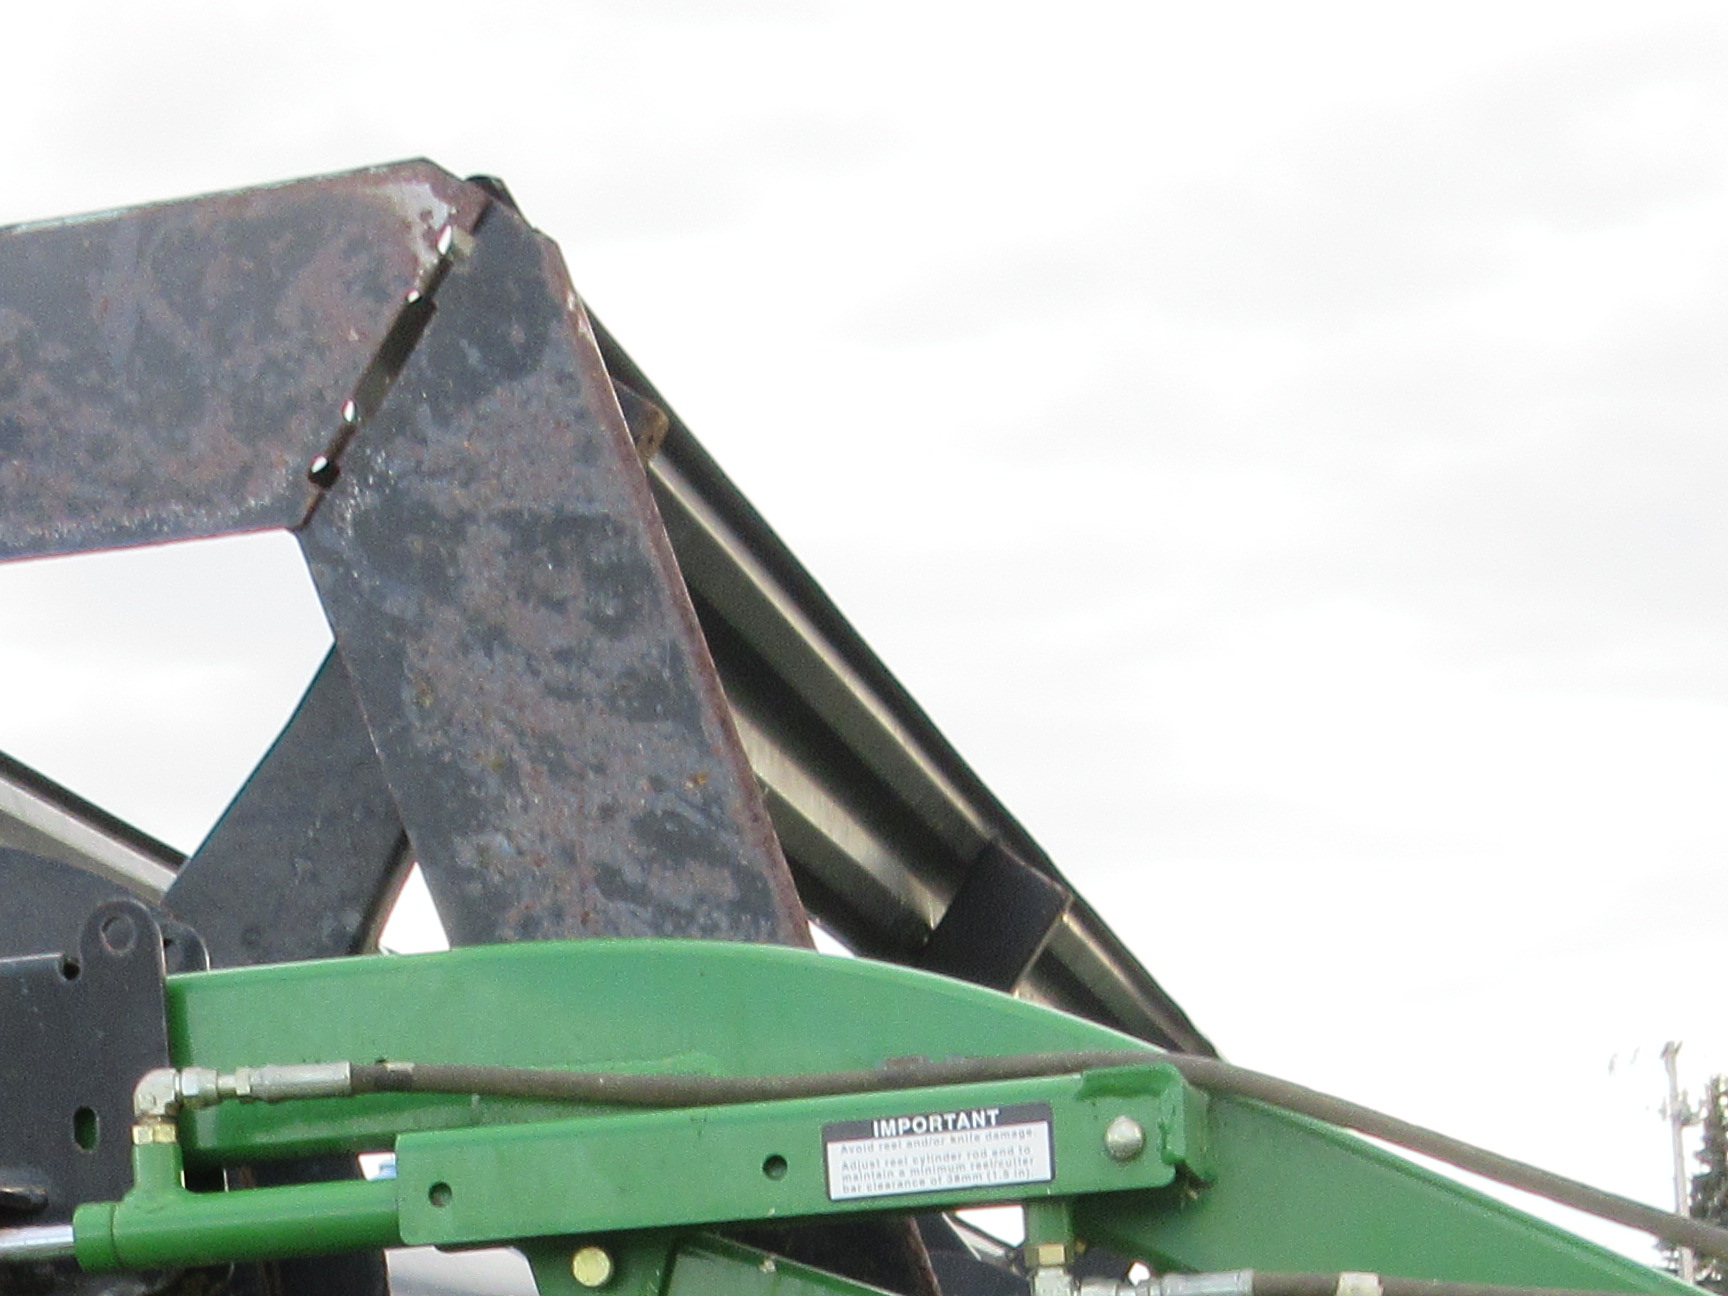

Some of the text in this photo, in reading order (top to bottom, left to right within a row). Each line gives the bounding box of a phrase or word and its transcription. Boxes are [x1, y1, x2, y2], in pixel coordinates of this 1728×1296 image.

[873, 1108, 1000, 1138] IMPORTANT
[841, 1143, 874, 1154] Avoid
[879, 1141, 902, 1150] reel
[906, 1136, 945, 1149] and/or
[950, 1133, 981, 1145] knife
[842, 1159, 880, 1172] Adjust
[885, 1157, 908, 1167] reel
[912, 1151, 962, 1167] cylinder
[967, 1148, 988, 1159] rod
[1018, 1145, 1031, 1155] to
[841, 1169, 894, 1182] maintain
[910, 1162, 966, 1177] minimum
[842, 1183, 862, 1194] bar
[866, 1178, 926, 1191] clearance
[930, 1175, 942, 1186] of
